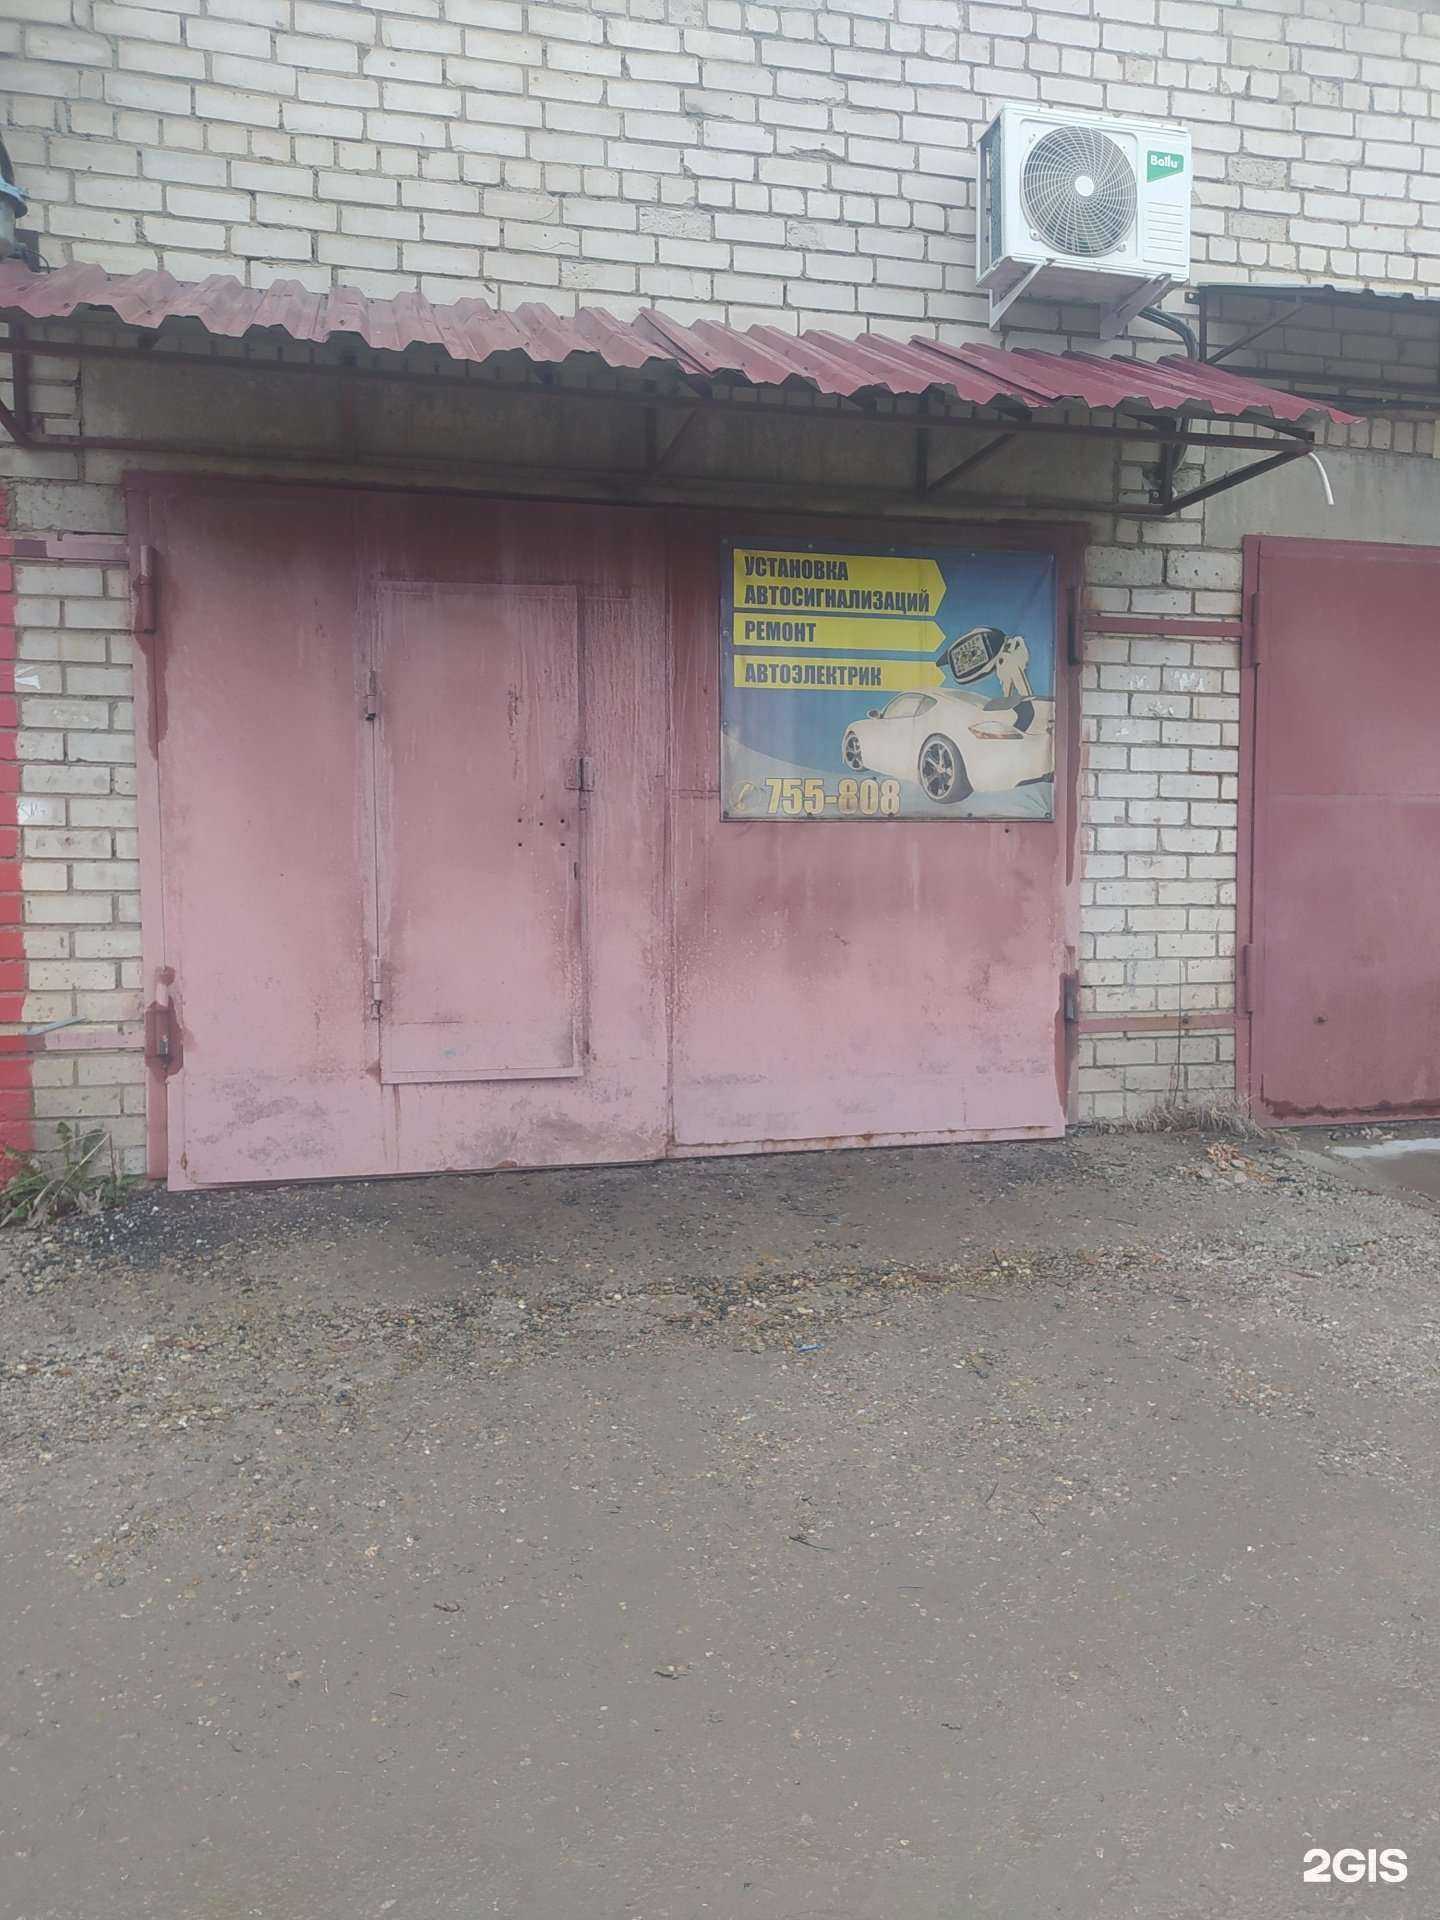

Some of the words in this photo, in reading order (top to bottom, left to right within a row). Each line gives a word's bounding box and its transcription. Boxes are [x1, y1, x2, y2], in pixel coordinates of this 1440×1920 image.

[1150, 154, 1178, 169] Ballu
[744, 555, 849, 581] УСТАНОВКА
[744, 585, 930, 614] АВТОСИГНАЛИЗАЦИЙ
[744, 620, 817, 642] РЕМОНТ
[744, 663, 882, 686] АВТОЭЛЕКТРИК
[766, 777, 901, 815] 755-808
